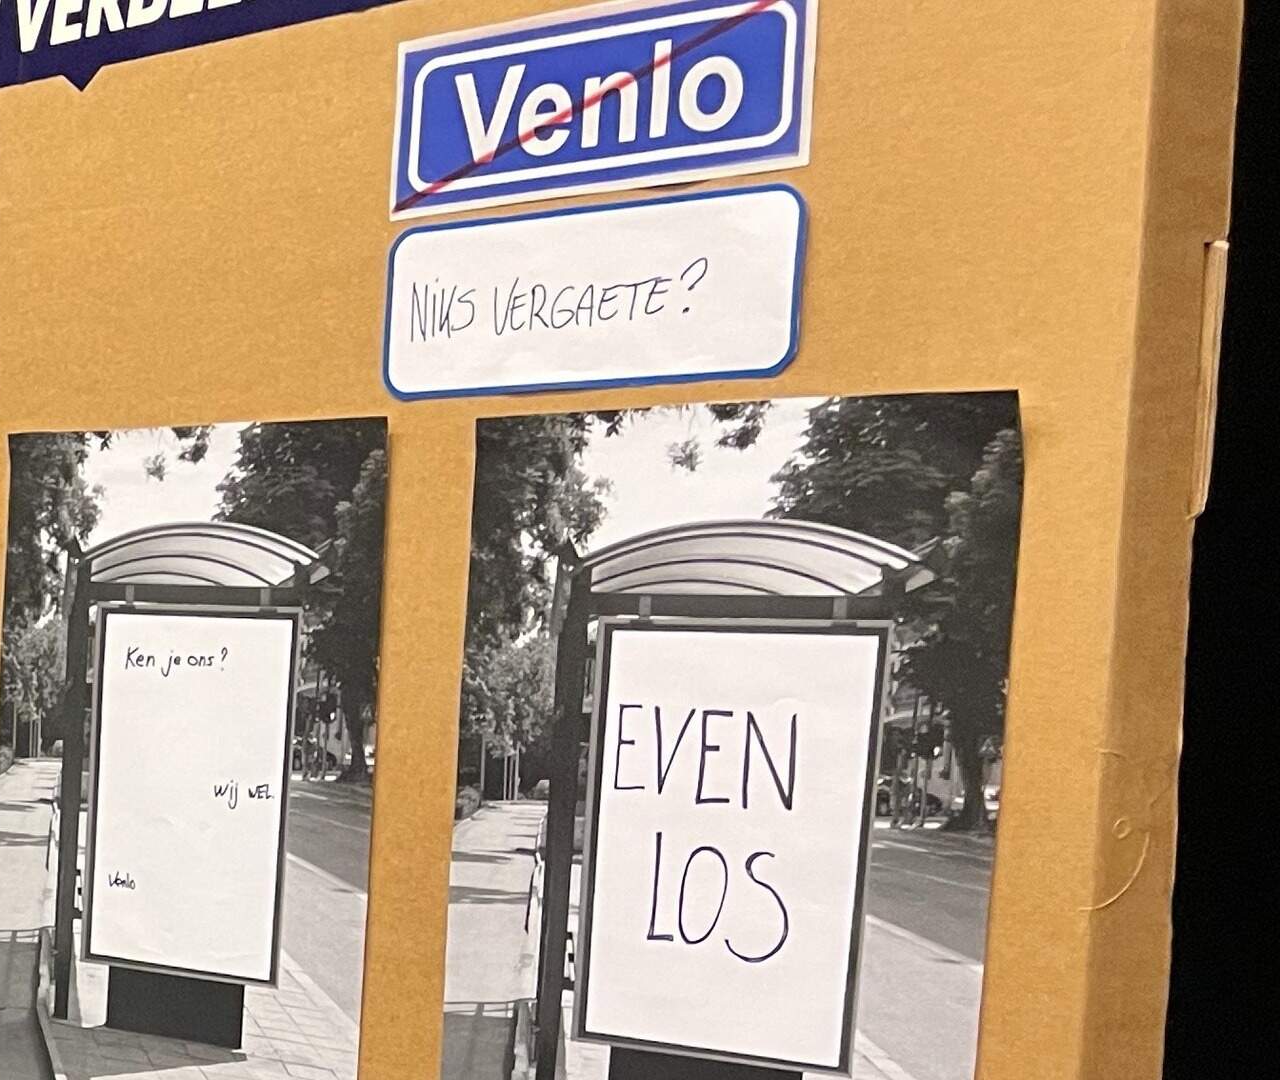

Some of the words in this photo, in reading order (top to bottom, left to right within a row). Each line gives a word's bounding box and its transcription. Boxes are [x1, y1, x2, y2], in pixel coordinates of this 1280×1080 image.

[455, 39, 744, 164] Venlo
[125, 646, 155, 671] Ken
[160, 650, 182, 678] je
[612, 703, 798, 812] EVEN
[646, 830, 790, 963] LOS
